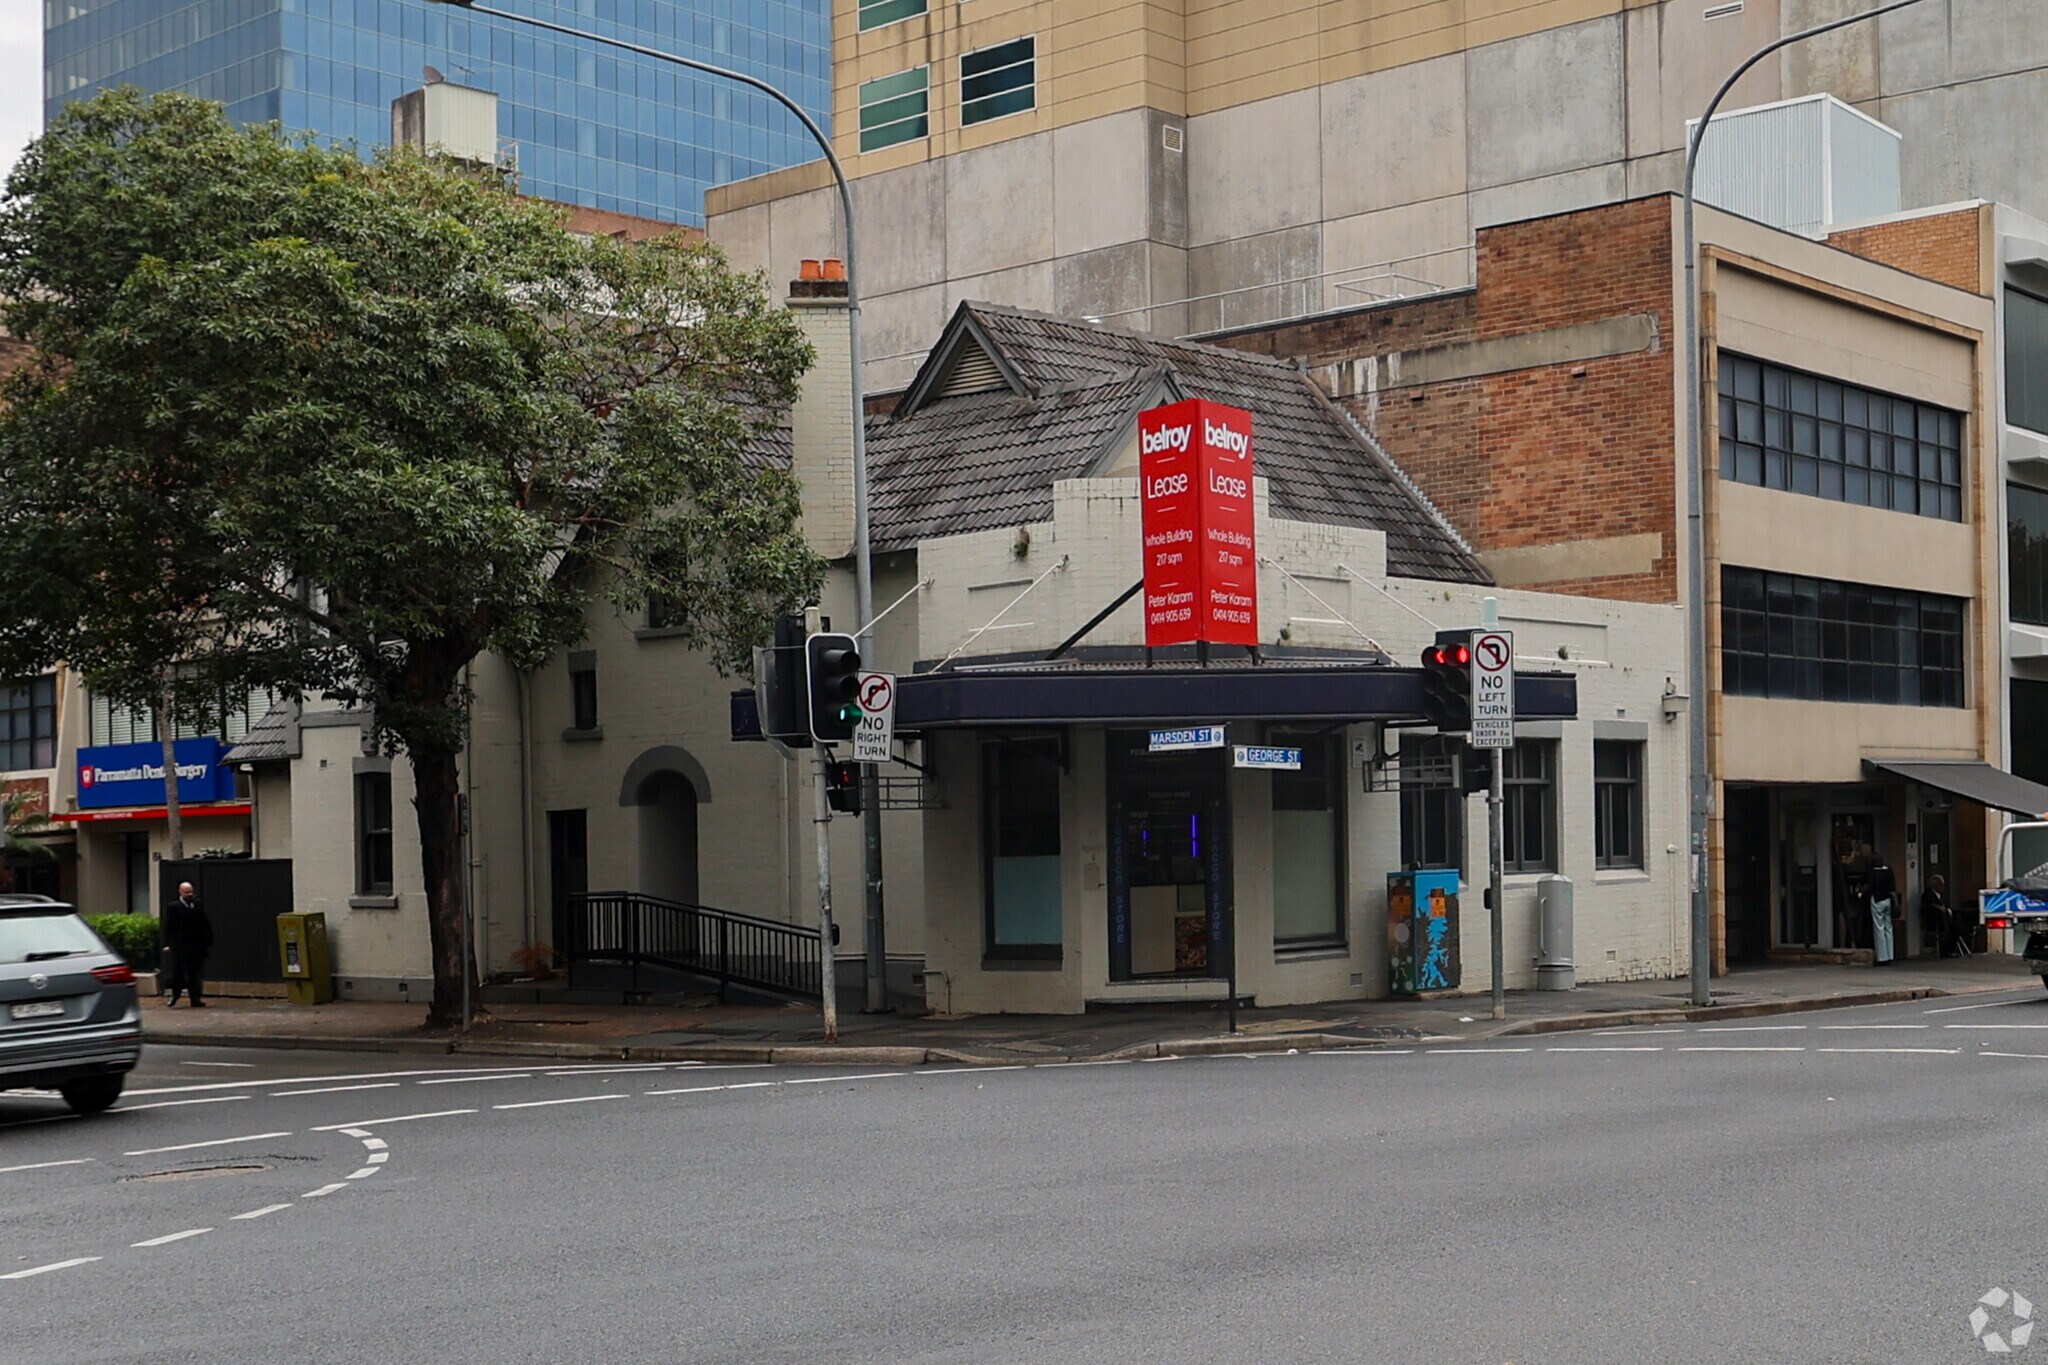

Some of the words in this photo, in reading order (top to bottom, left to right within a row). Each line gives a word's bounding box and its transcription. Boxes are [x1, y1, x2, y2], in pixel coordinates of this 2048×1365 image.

[1142, 424, 1191, 454] belroy
[1205, 418, 1248, 459] belroy
[1147, 473, 1187, 499] Lease
[1210, 468, 1246, 498] Lease
[1145, 533, 1166, 547] Whole
[1166, 529, 1193, 543] Building
[1207, 527, 1228, 542] Whole
[1228, 532, 1251, 549] Building
[1156, 553, 1167, 566] 217
[1168, 553, 1183, 566] sqm
[1229, 554, 1243, 567] sqm
[1148, 594, 1166, 608] Peter
[1167, 591, 1193, 605] Karam
[1210, 589, 1228, 604] Peter
[1229, 592, 1252, 607] Karam
[1481, 675, 1503, 689] NO
[1478, 692, 1506, 702] LEFT
[1478, 705, 1507, 715] TURN
[863, 716, 884, 731] NO
[1476, 721, 1509, 729] VEHICLES
[857, 732, 888, 743] RIGHT
[1151, 730, 1196, 744] MARSDEN
[1198, 729, 1210, 741] ST
[858, 746, 886, 756] TURN
[1248, 749, 1285, 762] GEORGE
[1287, 750, 1299, 763] ST
[1116, 895, 1125, 943] STORE
[1212, 892, 1222, 941] STORE
